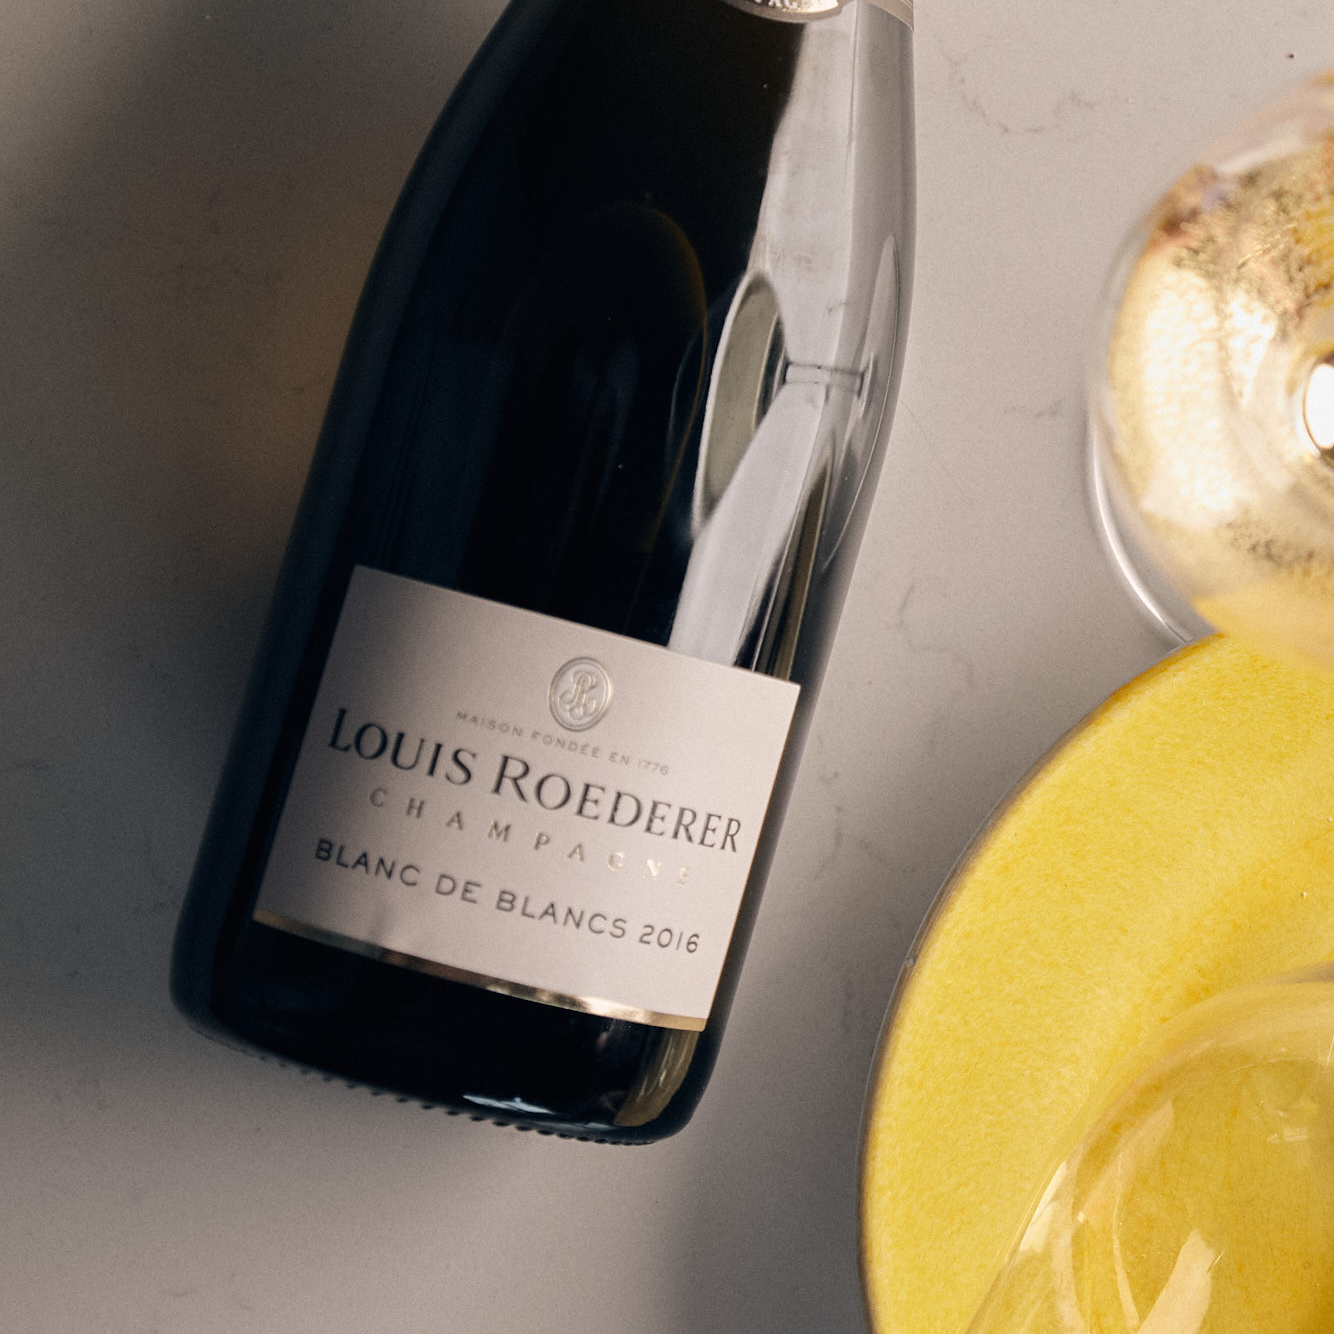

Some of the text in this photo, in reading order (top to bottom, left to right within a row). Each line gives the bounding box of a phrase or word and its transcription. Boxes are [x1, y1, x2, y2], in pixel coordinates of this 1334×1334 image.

[328, 708, 742, 854] LOUIS ROEDERER
[456, 711, 670, 777] MAISON FONDÉE EN 1776
[370, 787, 688, 884] CHAMPAGNE
[315, 838, 700, 954] BLANC DE BLANCS 2016
